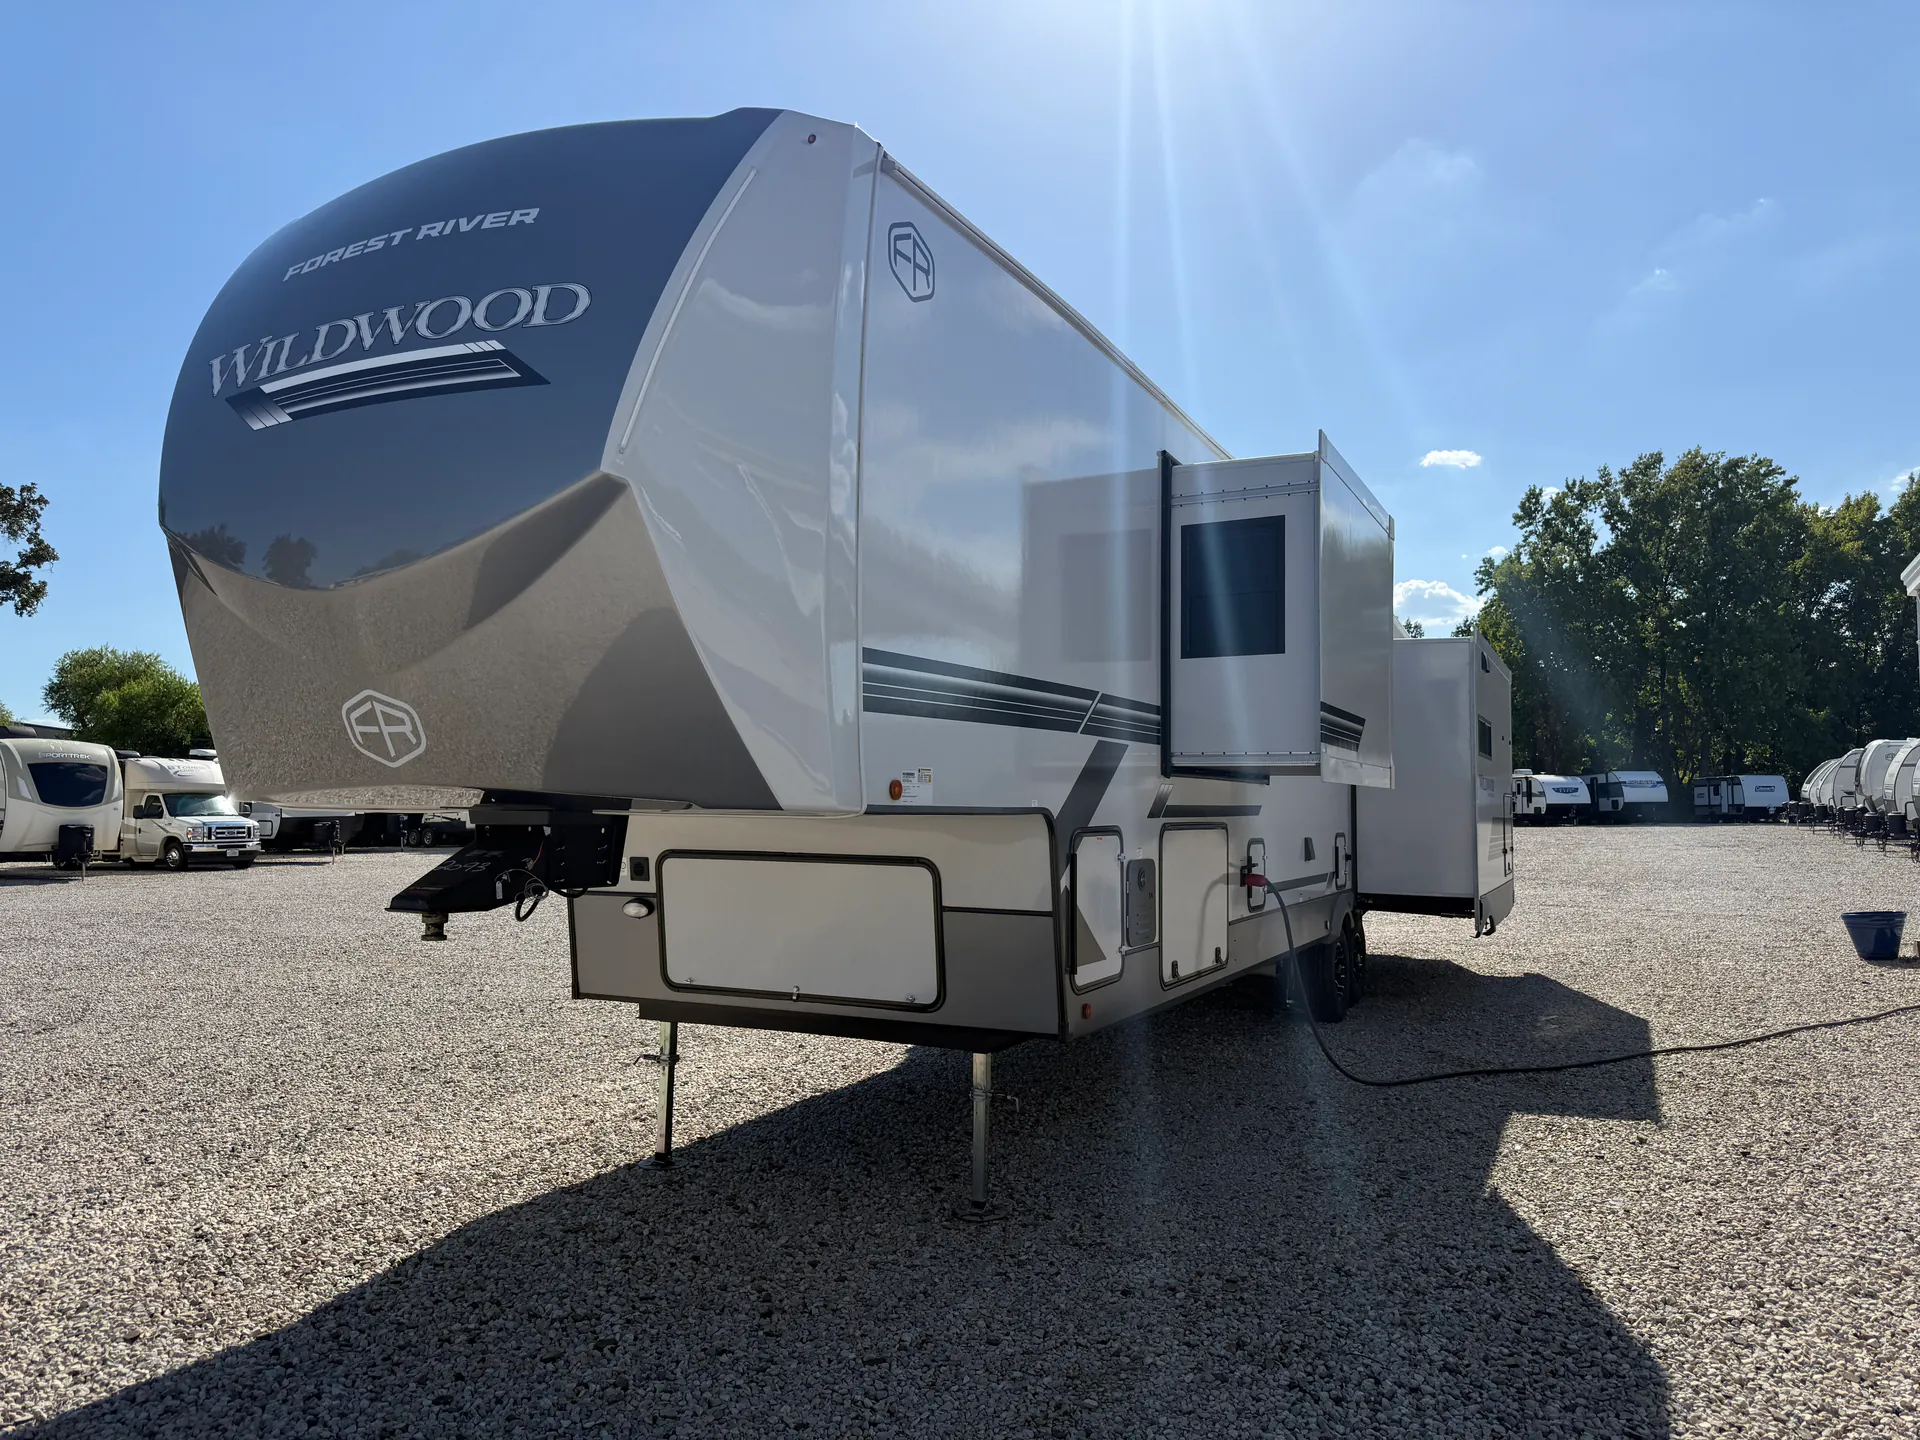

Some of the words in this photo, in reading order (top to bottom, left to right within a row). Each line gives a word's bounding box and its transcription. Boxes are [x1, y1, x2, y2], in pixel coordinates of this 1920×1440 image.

[283, 228, 413, 282] FOREST
[416, 207, 540, 240] RIVER
[208, 282, 593, 398] WILDWOOD
